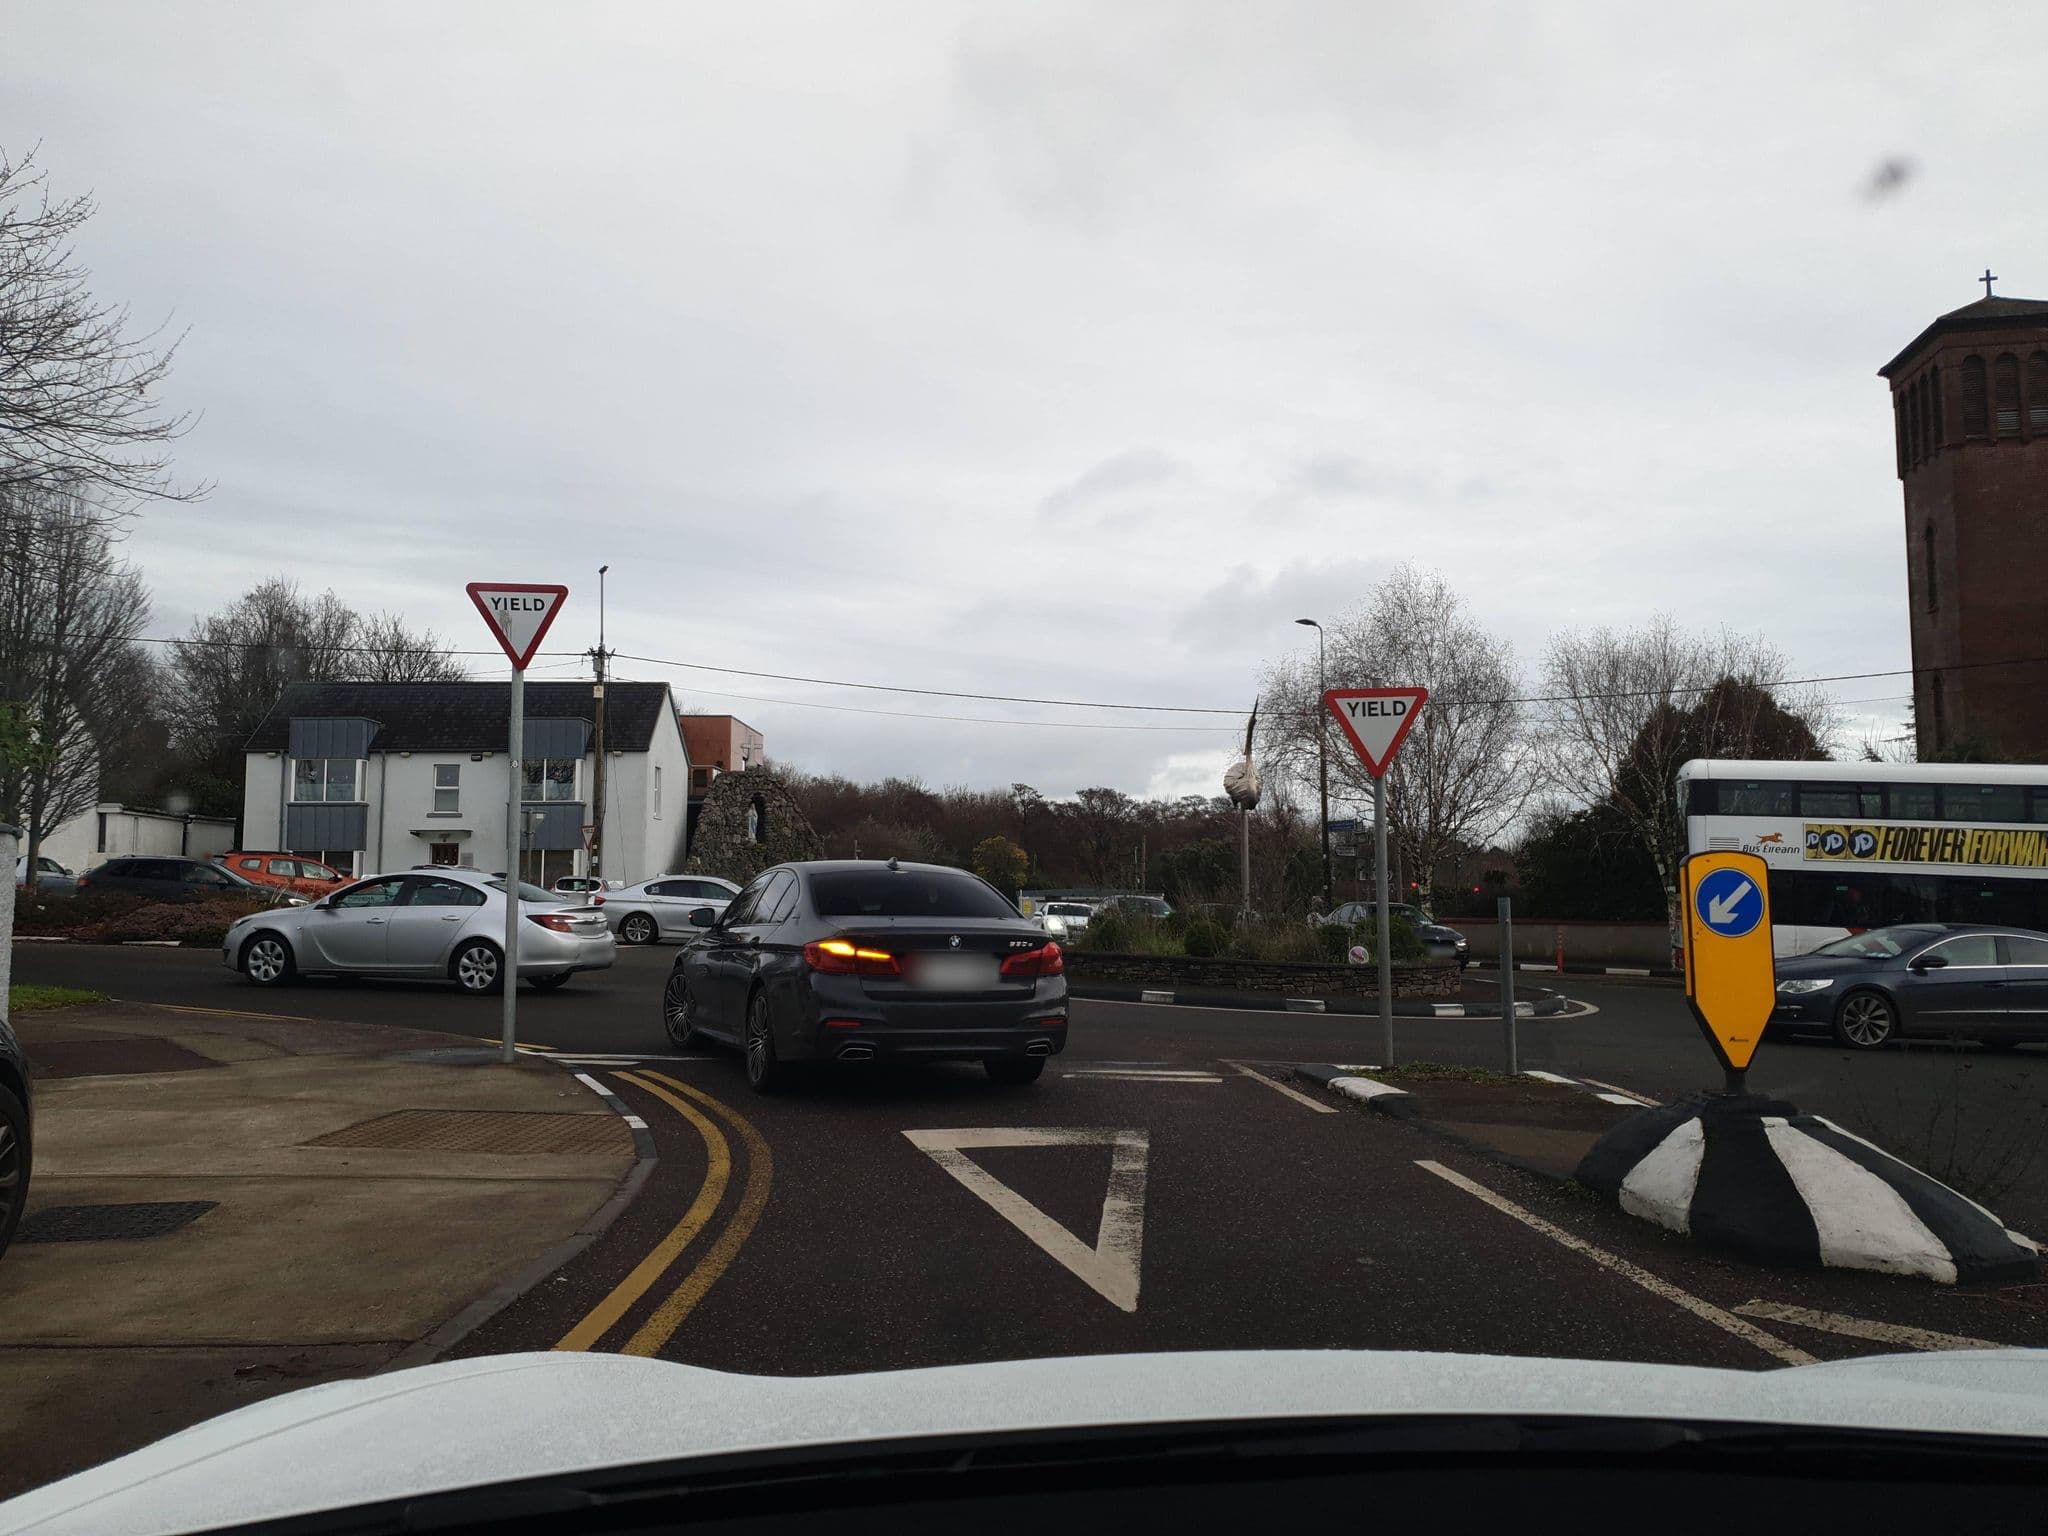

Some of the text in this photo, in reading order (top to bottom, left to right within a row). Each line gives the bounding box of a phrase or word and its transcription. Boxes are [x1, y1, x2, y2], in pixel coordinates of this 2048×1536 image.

[491, 597, 545, 611] YIELD
[1347, 701, 1406, 717] YIELD
[1742, 844, 1760, 853] Bus
[1825, 833, 1843, 852] JD
[1852, 833, 1874, 855] JD
[1880, 826, 1967, 863] FOREVER
